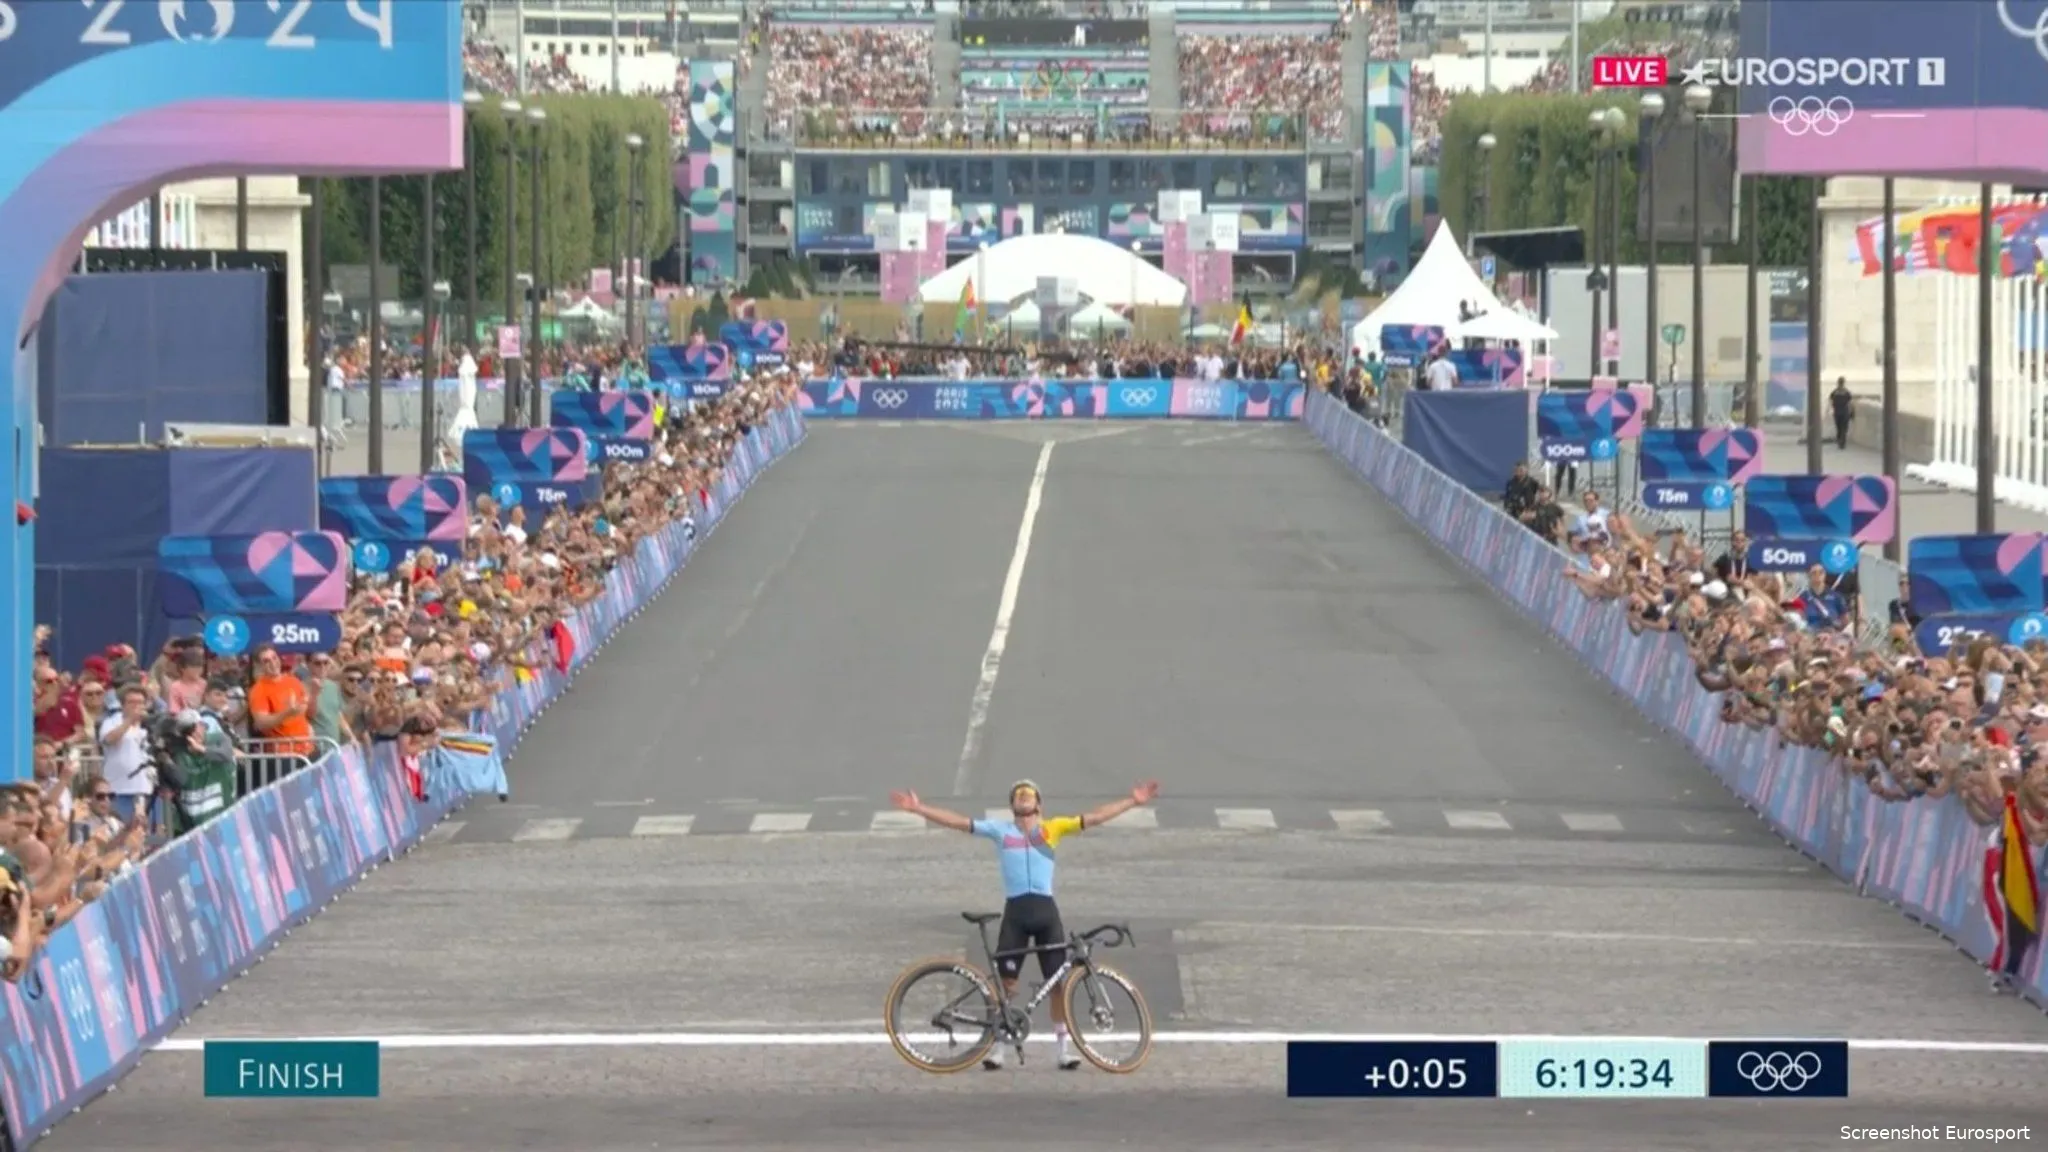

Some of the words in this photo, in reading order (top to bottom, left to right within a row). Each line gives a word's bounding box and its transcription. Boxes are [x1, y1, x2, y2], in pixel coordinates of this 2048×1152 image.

[605, 444, 644, 458] 100m
[1546, 443, 1586, 457] 100m
[536, 487, 568, 502] 75m
[1656, 488, 1689, 502] 75m
[404, 549, 448, 567] 5m
[1761, 547, 1806, 565] 50m
[271, 624, 320, 644] 25m
